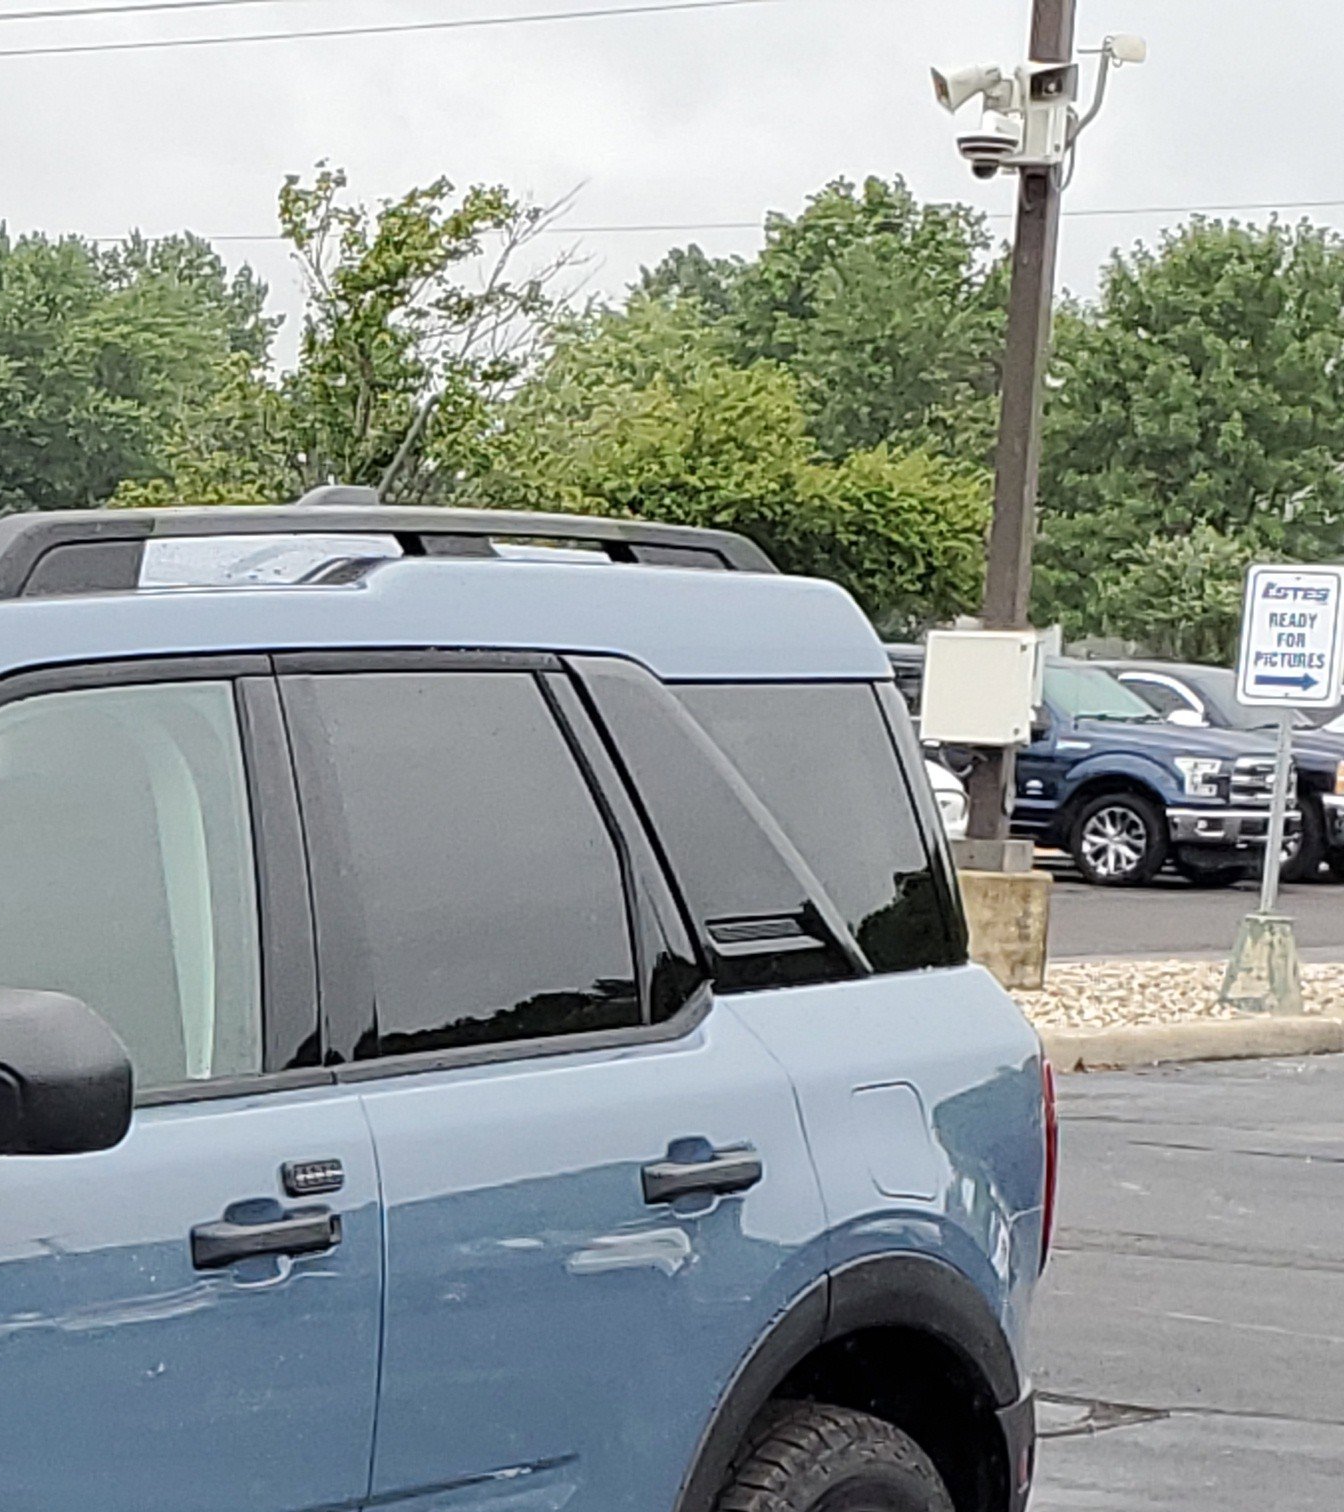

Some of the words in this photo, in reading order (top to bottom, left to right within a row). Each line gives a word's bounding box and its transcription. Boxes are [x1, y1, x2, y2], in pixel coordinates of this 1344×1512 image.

[1261, 582, 1330, 602] ESTES
[1269, 612, 1318, 629] READY
[1276, 632, 1307, 648] FOR
[1253, 651, 1326, 670] PICTURES
